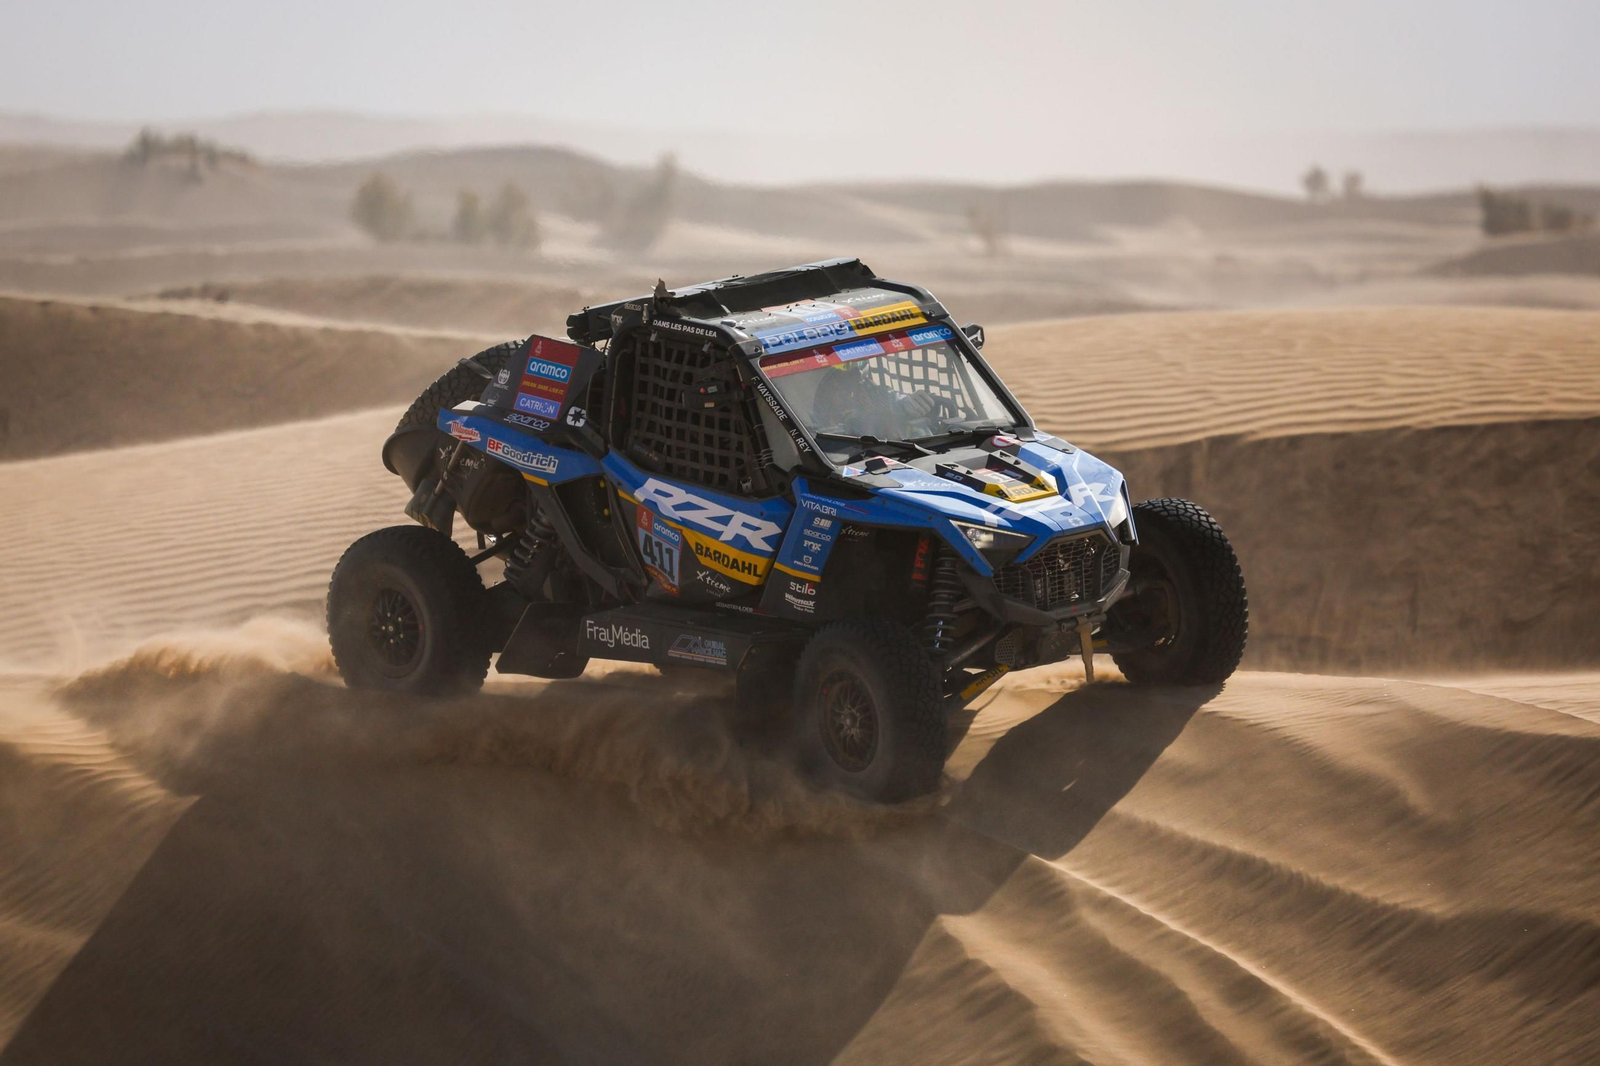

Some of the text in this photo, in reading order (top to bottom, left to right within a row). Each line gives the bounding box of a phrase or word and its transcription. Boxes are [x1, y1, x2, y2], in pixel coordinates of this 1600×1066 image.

[652, 319, 670, 329] DANS
[670, 322, 682, 331] LES
[682, 325, 695, 334] PAS
[705, 330, 717, 338] LEA
[853, 308, 919, 330] BARDAHL
[764, 321, 850, 349] POLARIS
[912, 327, 952, 341] aramco
[529, 360, 569, 380] aramco
[751, 375, 788, 421] F. VAYSSADE
[504, 413, 550, 431] sparco
[789, 428, 812, 453] N. REY
[488, 438, 556, 469] BFGoodrich
[634, 477, 783, 552] RZR
[801, 499, 837, 516] VITABRI
[653, 522, 680, 542] aramco
[803, 528, 832, 542] sparco
[642, 532, 676, 583] 411
[695, 541, 763, 578] BARDAHL
[696, 570, 731, 593] X'treme
[785, 592, 816, 607] Winmax
[586, 619, 650, 650] FrayMédia
